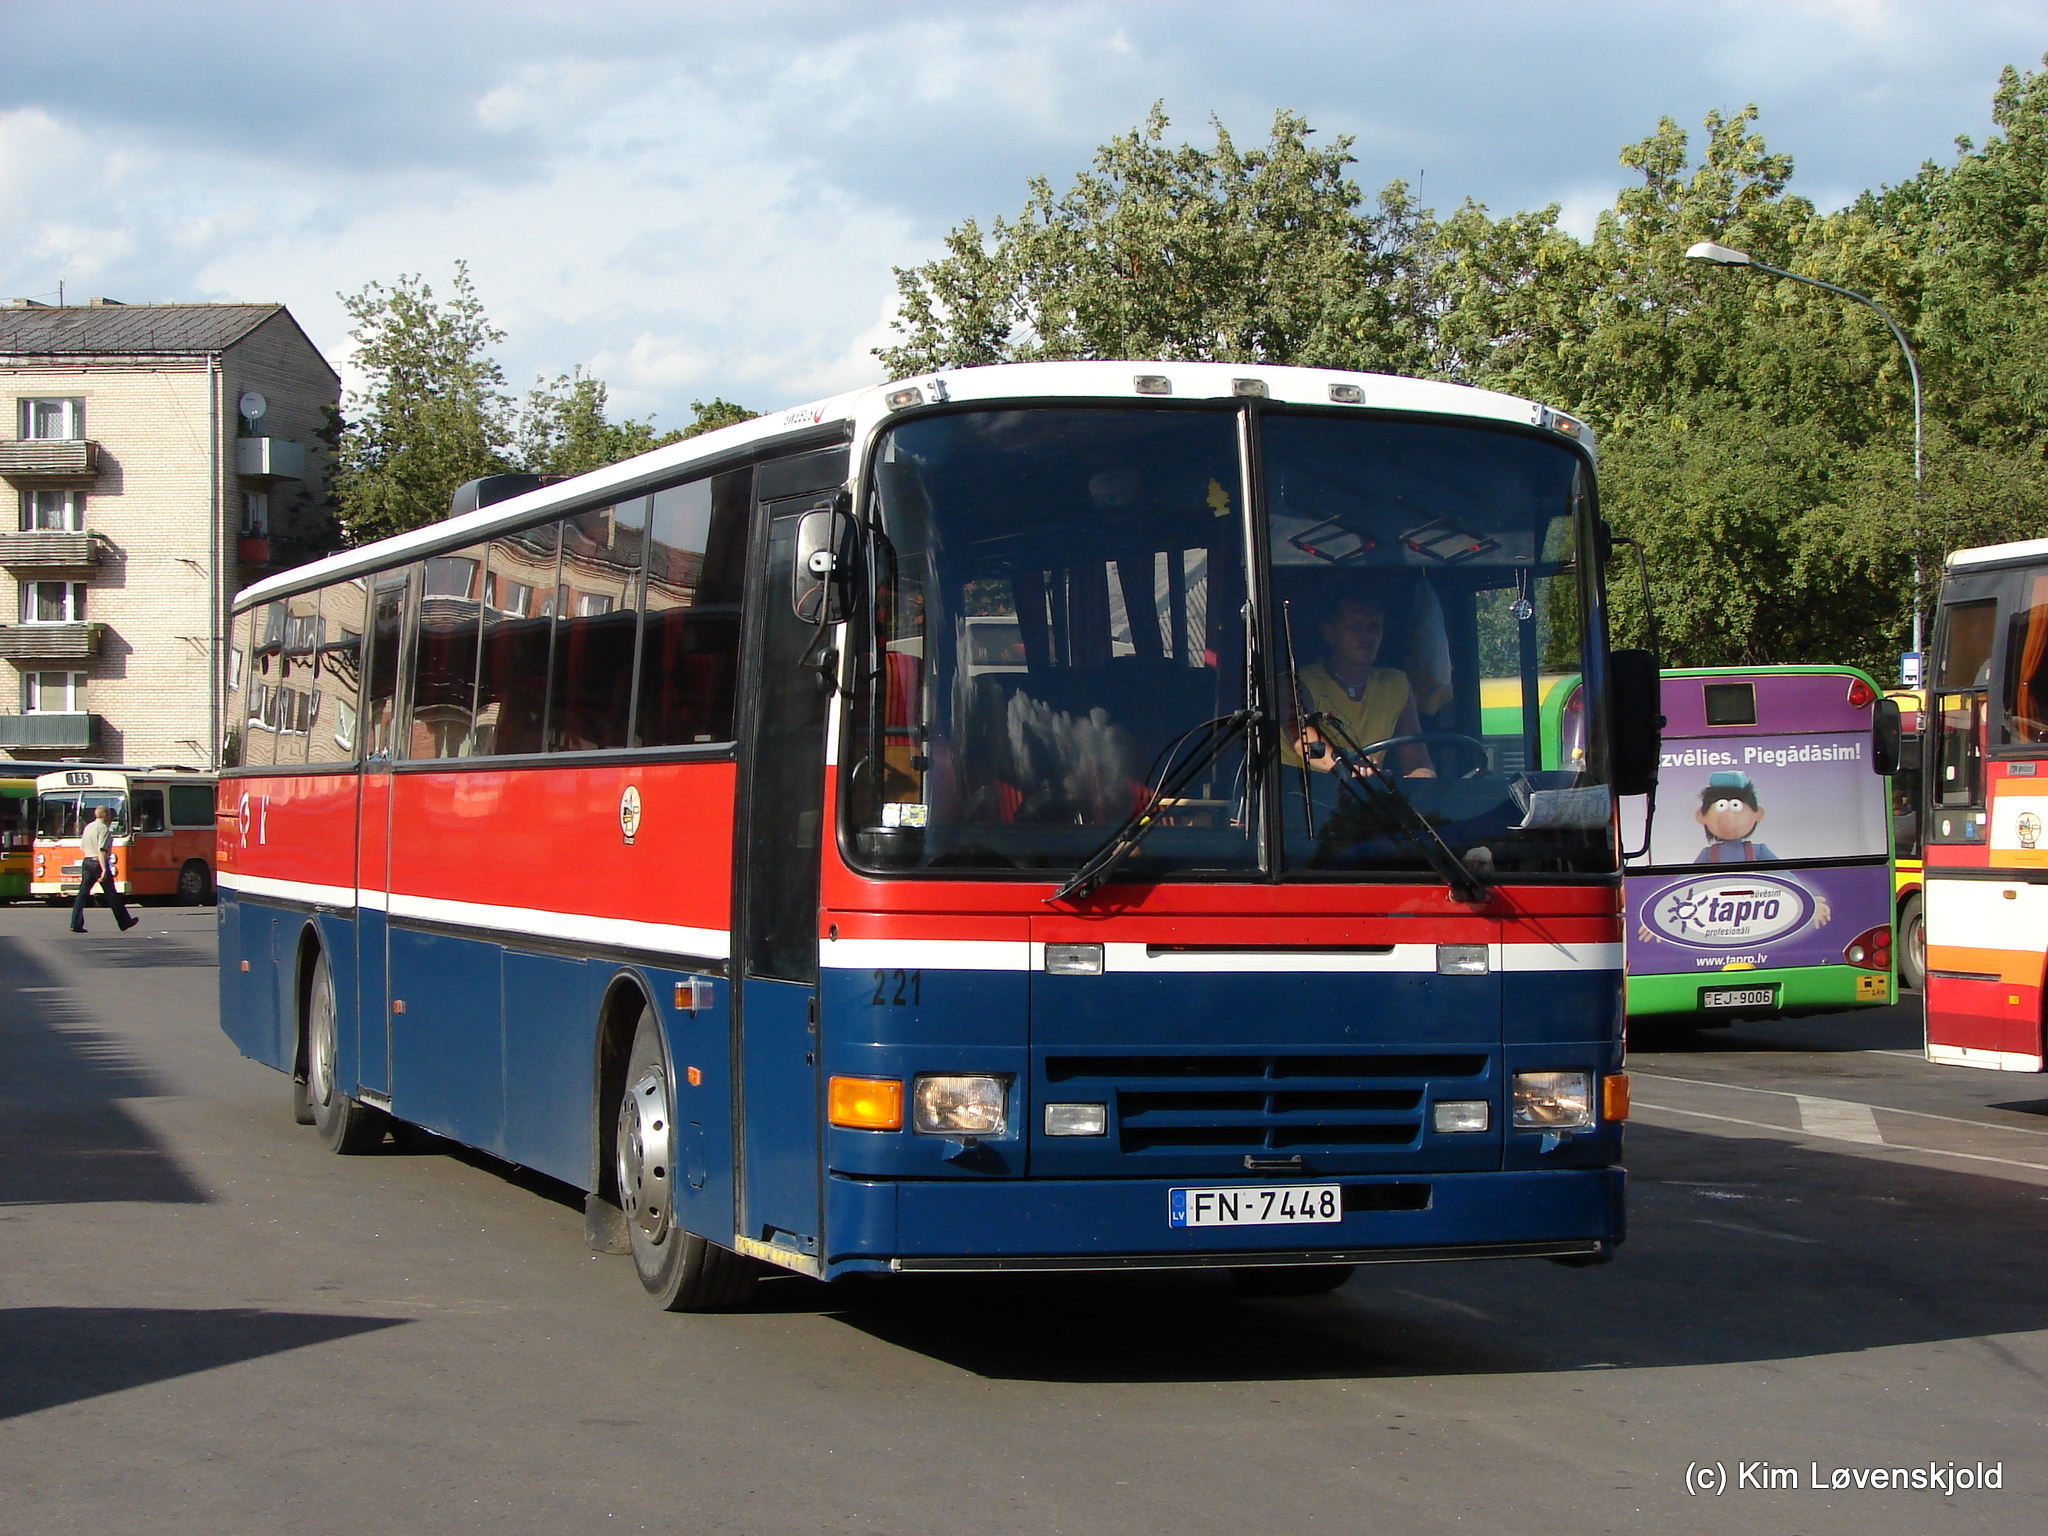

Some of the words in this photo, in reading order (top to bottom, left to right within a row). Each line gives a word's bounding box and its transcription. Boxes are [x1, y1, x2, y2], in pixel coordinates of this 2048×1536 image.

[1658, 748, 1738, 767] zvēlies.
[1744, 743, 1860, 767] Piegādāsim!
[71, 773, 89, 783] 135
[1708, 898, 1779, 927] tapro
[1696, 953, 1767, 966] www.tapro.lv
[872, 968, 921, 1006] 221
[1714, 991, 1770, 1006] EJ-9006
[1195, 1190, 1335, 1222] FN-7448
[1172, 1211, 1185, 1221] LV
